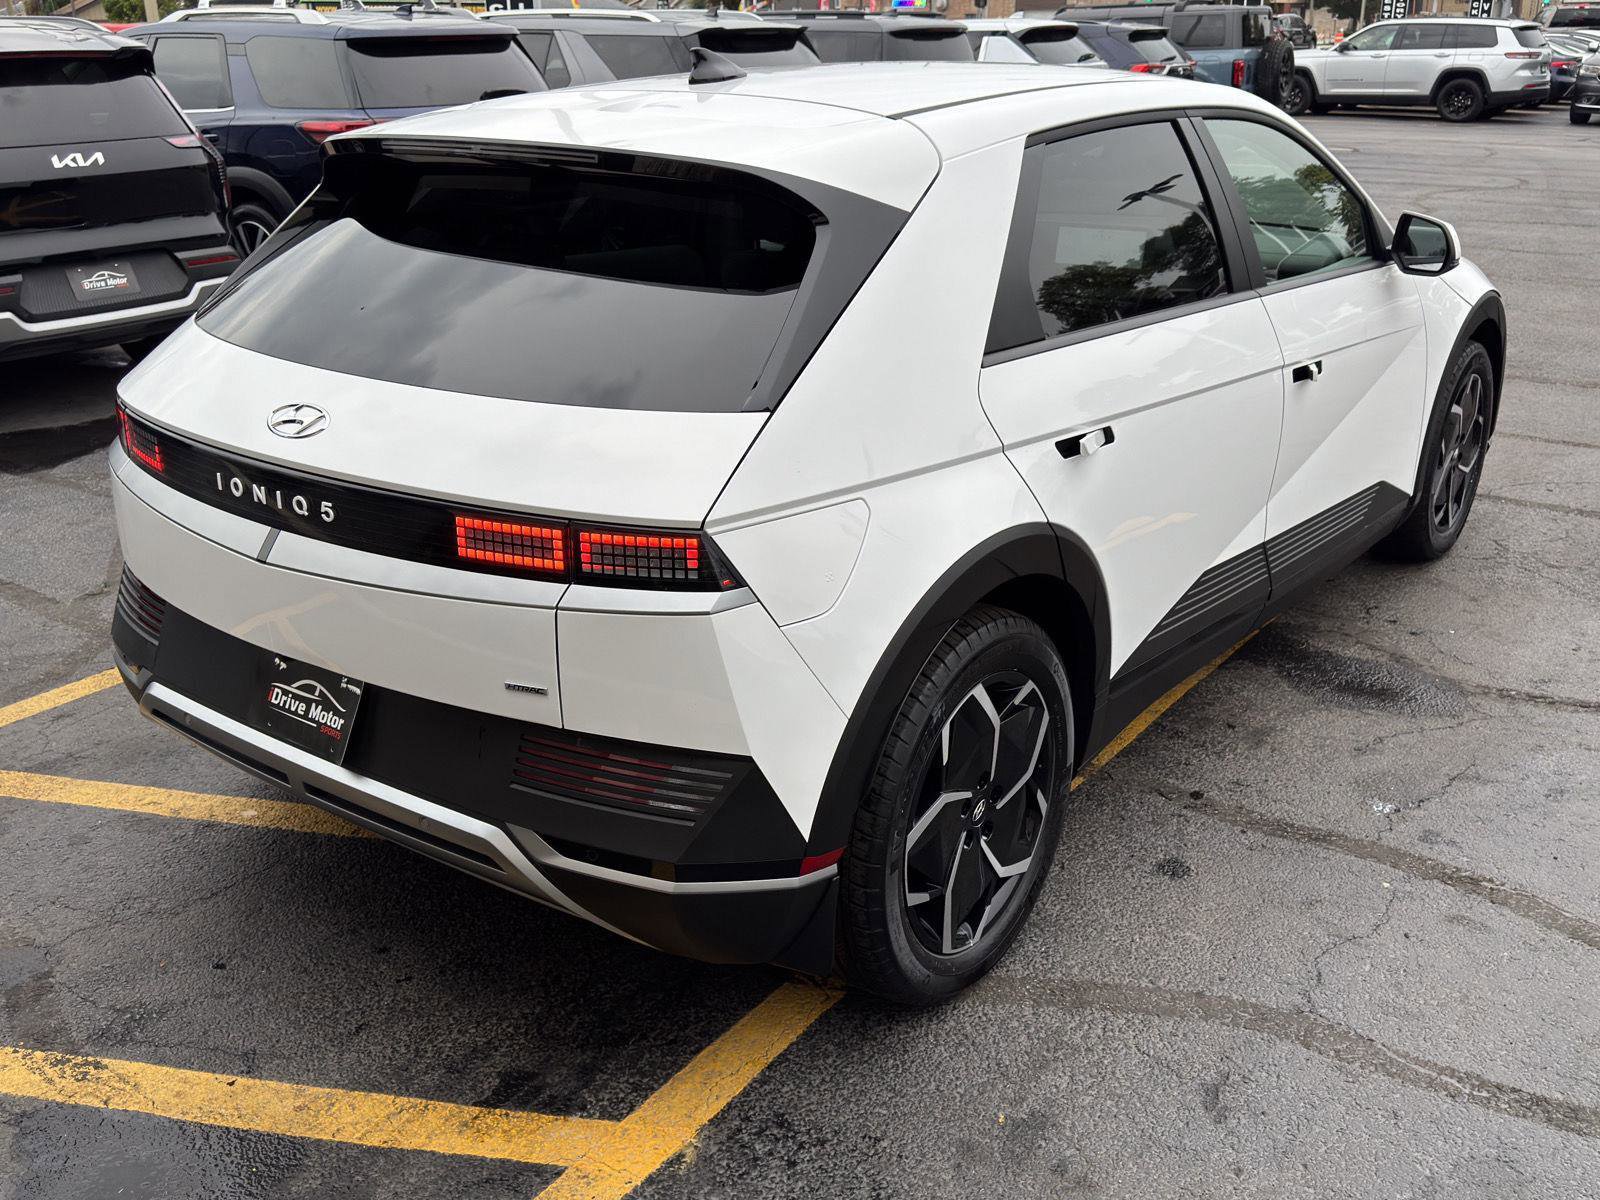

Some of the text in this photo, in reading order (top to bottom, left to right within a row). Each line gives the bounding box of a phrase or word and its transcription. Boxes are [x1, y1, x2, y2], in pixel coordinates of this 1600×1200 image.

[1395, 0, 1406, 18] ORY
[50, 151, 105, 169] KIA
[106, 277, 128, 286] Motor
[216, 472, 335, 523] IONIQ 5
[267, 687, 345, 731] iDrive Motor
[319, 725, 343, 741] SPORTS
